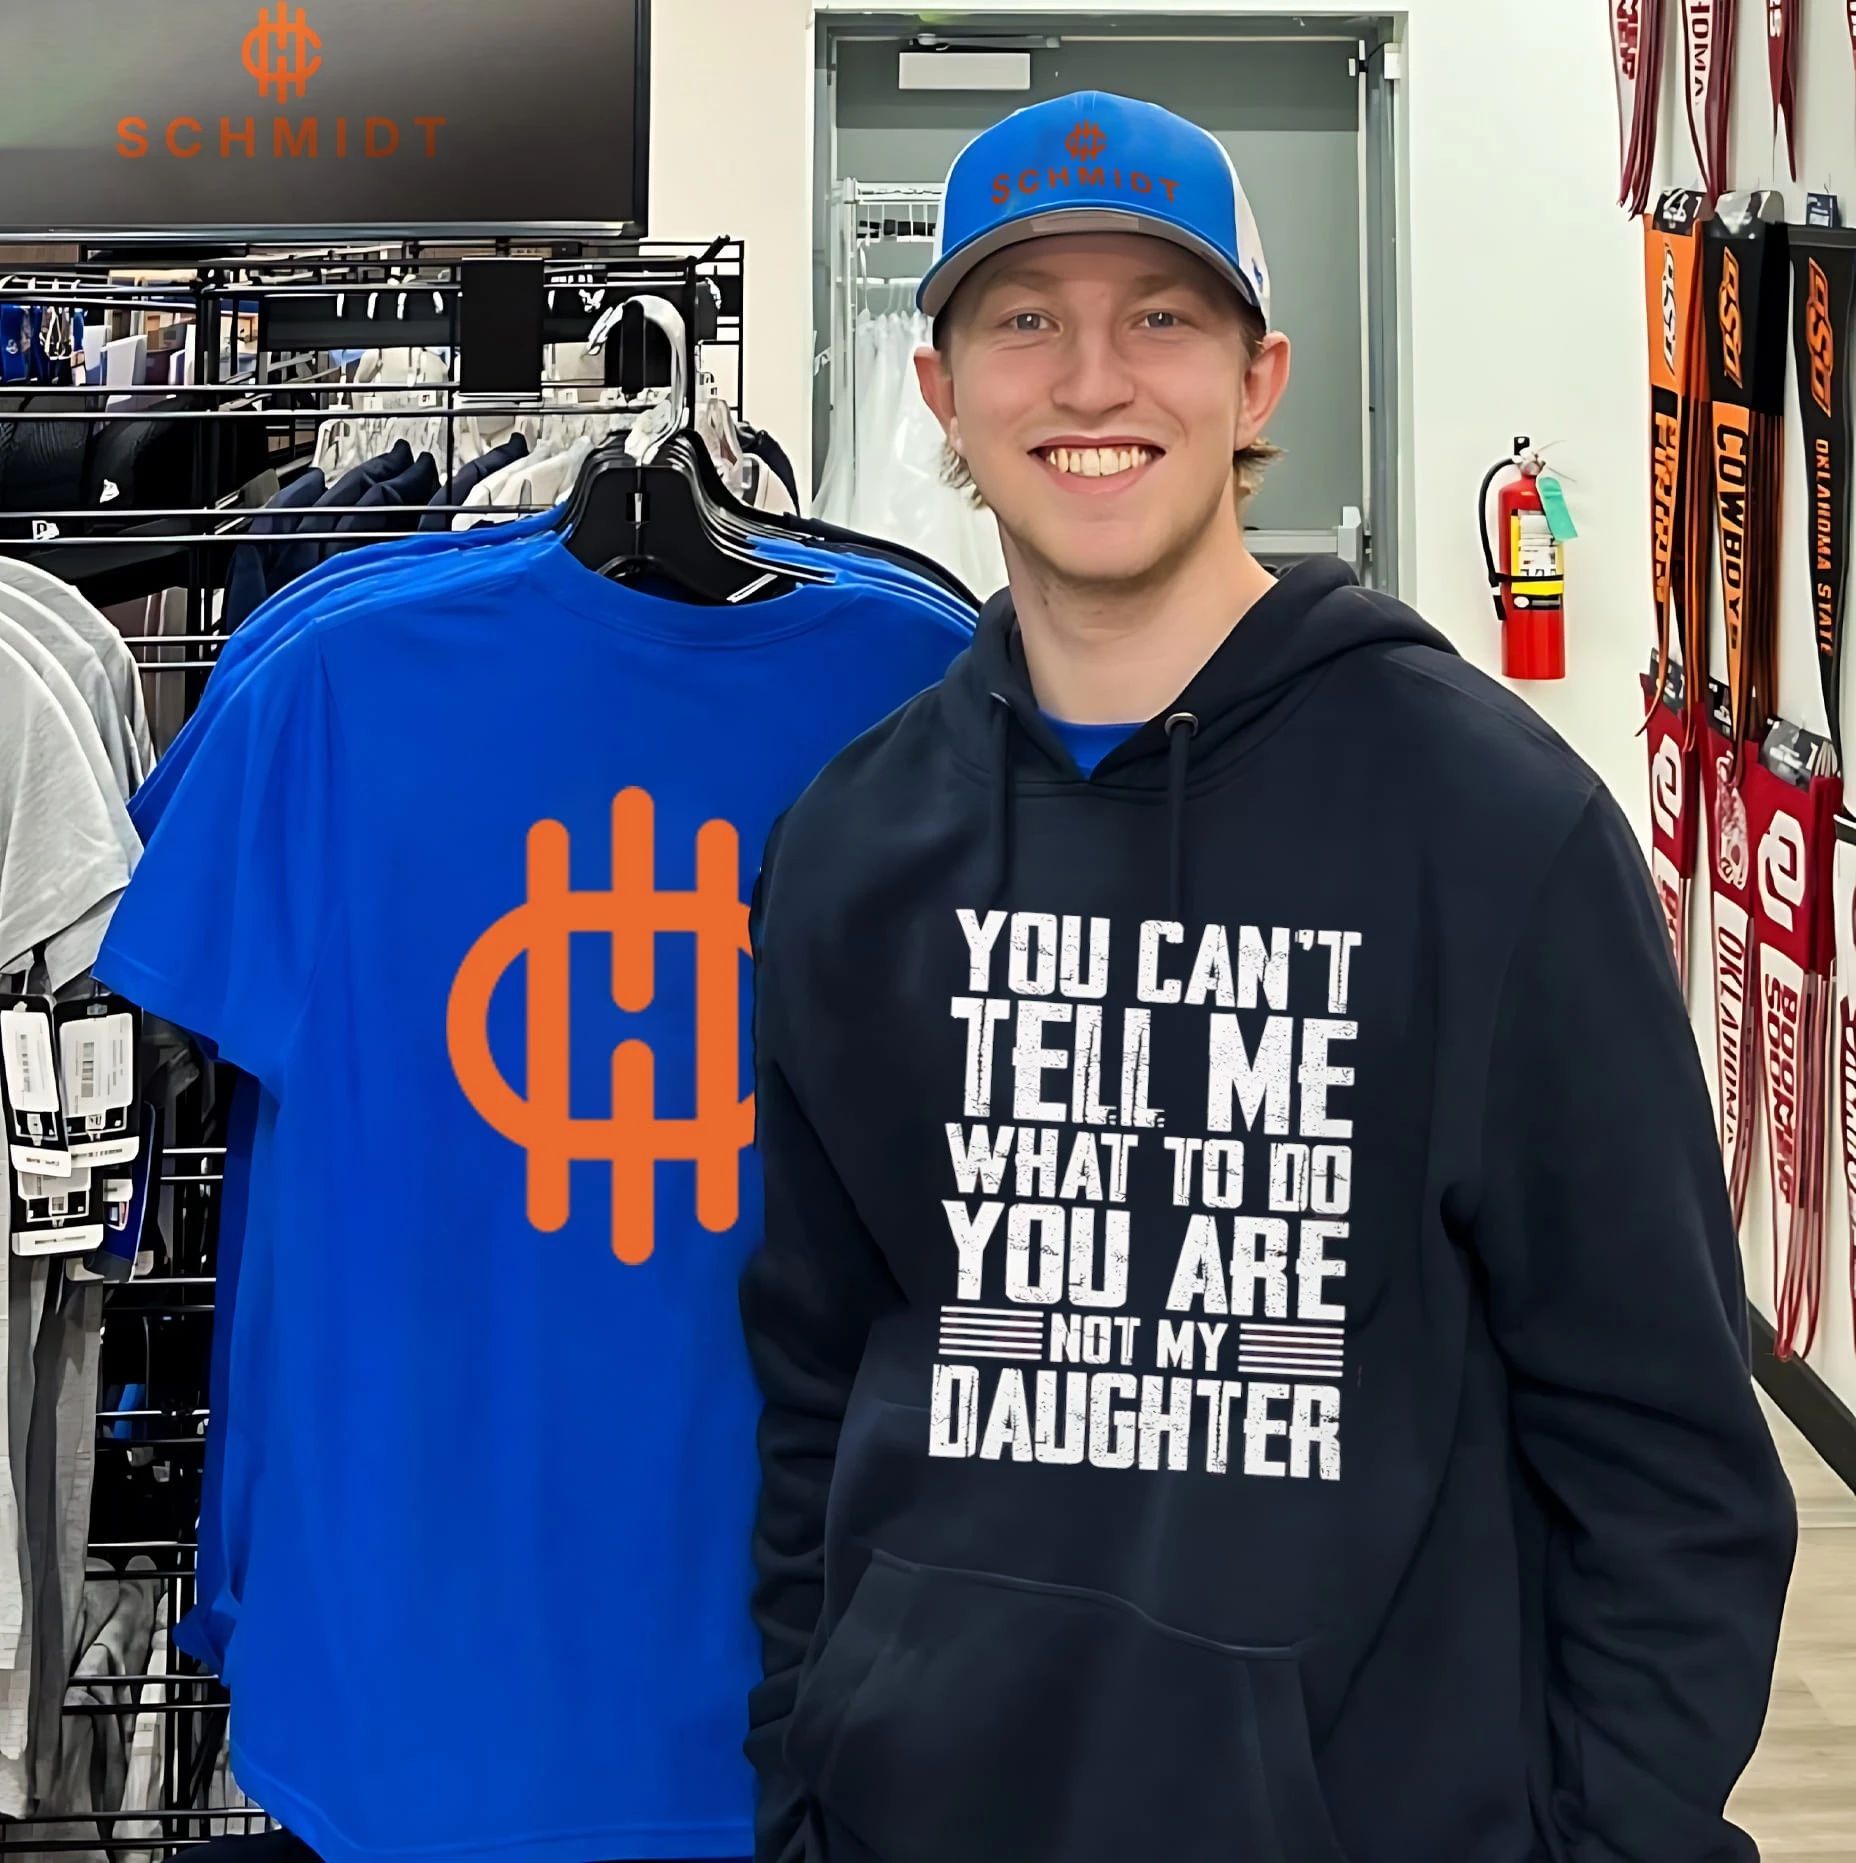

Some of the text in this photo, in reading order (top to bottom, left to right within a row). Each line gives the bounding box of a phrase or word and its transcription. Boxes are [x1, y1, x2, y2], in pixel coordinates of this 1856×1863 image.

[115, 115, 447, 160] SCHMIDT
[991, 166, 1179, 205] SCHMIDT
[1814, 438, 1833, 570] OKLAHOMA
[955, 908, 1363, 1014] YOU CAN'T
[950, 996, 1359, 1139] TELL ME
[944, 1122, 1352, 1215] WHAT TO DO
[941, 1199, 1350, 1321] YOU ARE
[1049, 1312, 1229, 1372] NOT MY
[928, 1363, 1341, 1481] DAUGHTER
